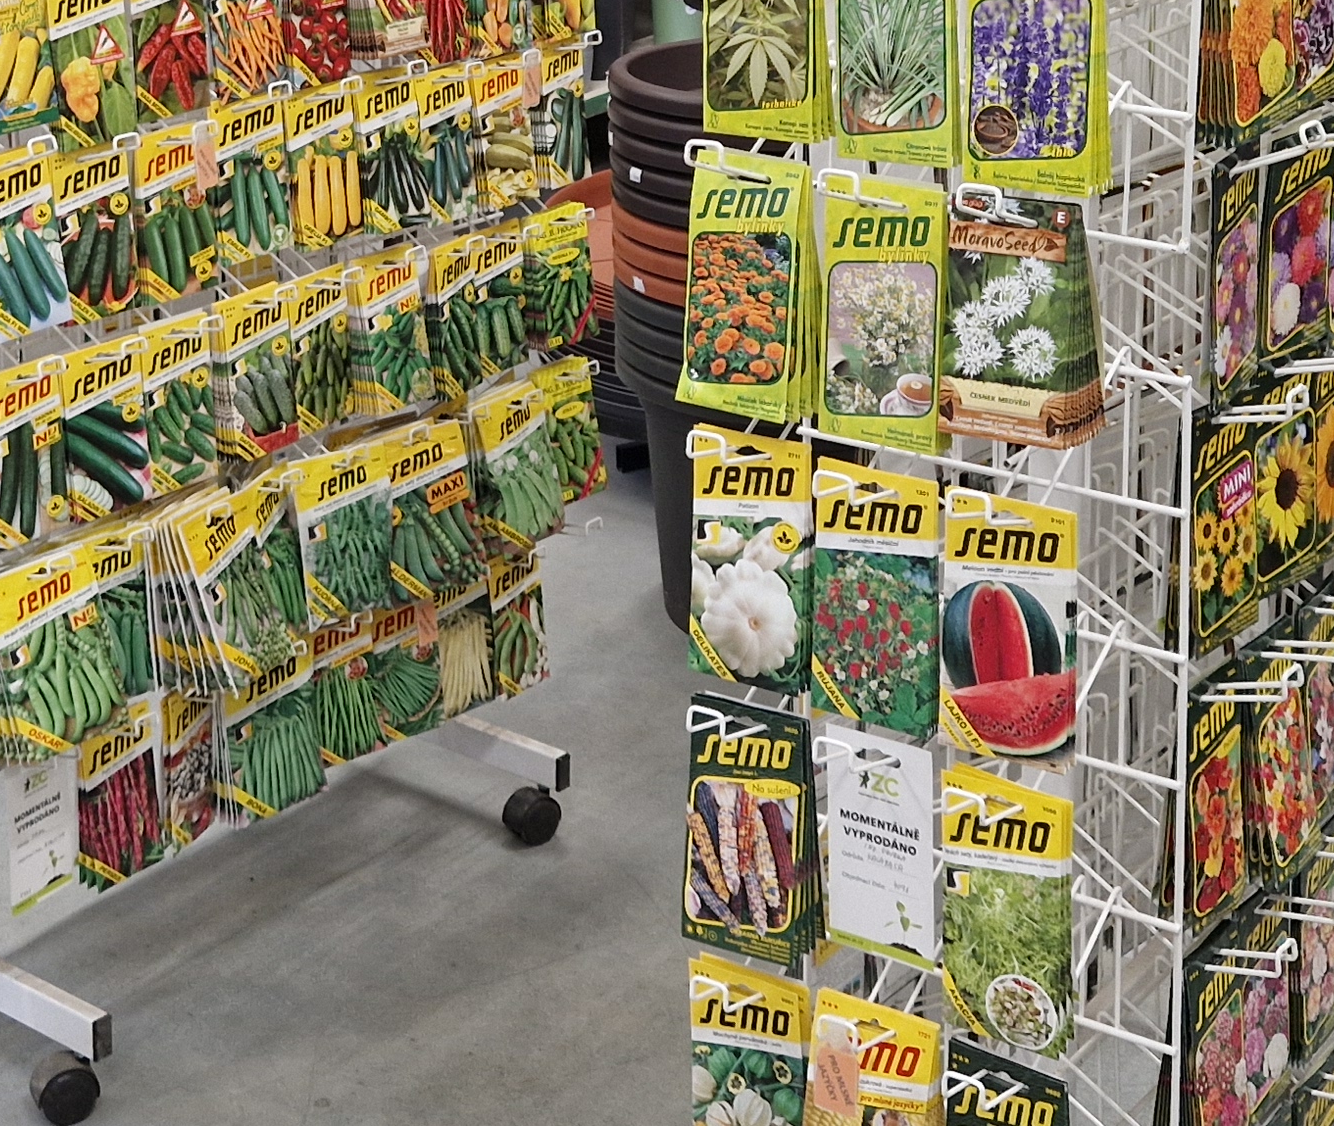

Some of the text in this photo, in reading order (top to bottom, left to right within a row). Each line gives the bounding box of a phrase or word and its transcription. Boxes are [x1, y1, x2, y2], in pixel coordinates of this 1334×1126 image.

[696, 186, 790, 220] semo
[735, 218, 785, 236] bylinky
[833, 214, 930, 249] semo
[877, 246, 929, 265] bylinky
[389, 441, 443, 481] semo
[429, 476, 464, 501] MAXI
[702, 464, 796, 496] semo
[824, 498, 924, 534] semo
[954, 526, 1060, 563] semo
[693, 628, 730, 680] DELIKATES
[815, 669, 847, 711] RUJANA
[944, 699, 968, 729] LAJKO
[697, 732, 794, 769] semo
[839, 807, 920, 842] MOMENTÁLNĚ
[843, 825, 918, 856] VYPRODÁNO
